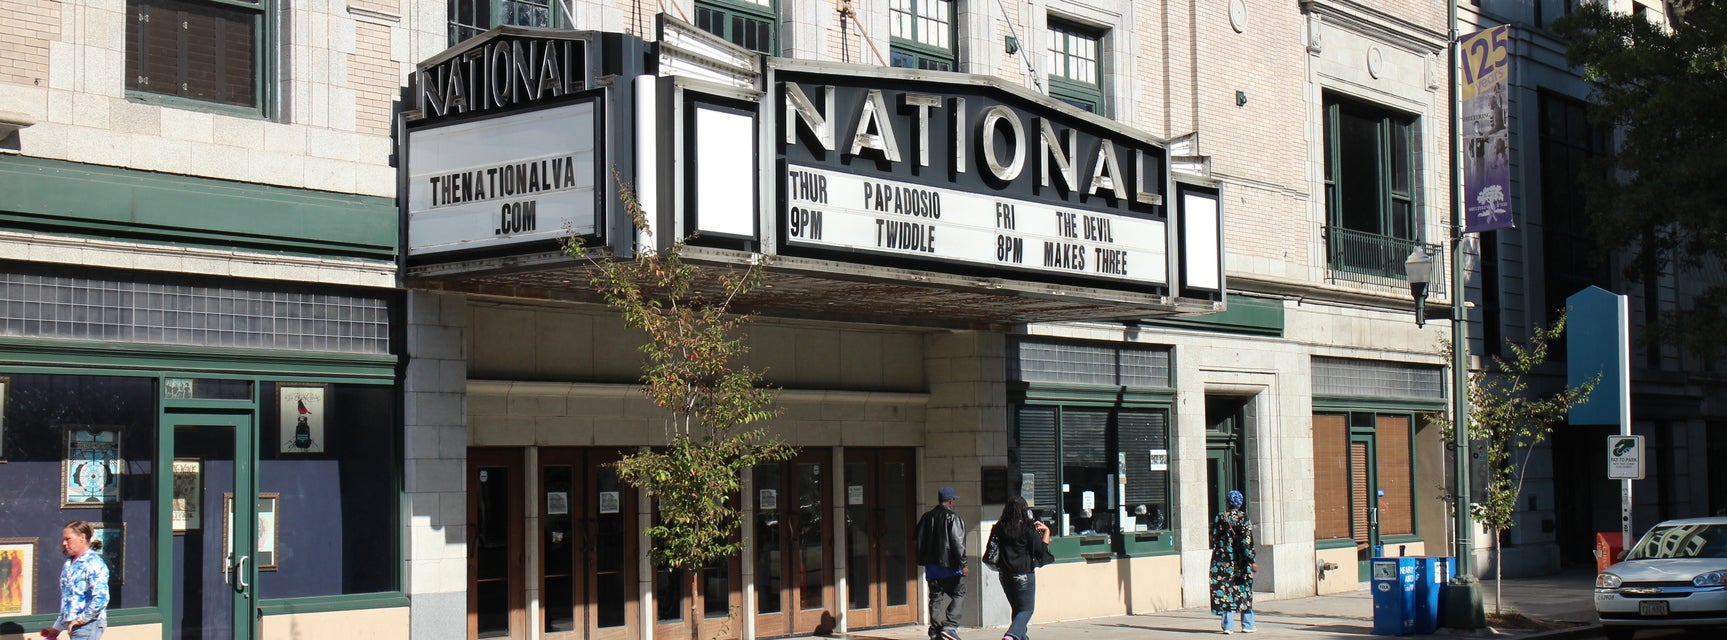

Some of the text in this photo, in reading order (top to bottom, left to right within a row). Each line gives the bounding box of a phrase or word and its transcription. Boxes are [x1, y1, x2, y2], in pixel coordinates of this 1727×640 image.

[422, 39, 585, 118] NATIONAL
[1461, 26, 1508, 84] 125
[1475, 68, 1504, 94] years
[784, 81, 1162, 206] NATIONAL
[430, 156, 575, 206] THENATIONALVA
[789, 170, 941, 220] THUR PAPADOSIO
[495, 200, 536, 235] .COM
[790, 206, 935, 253] 9PM TWIDDLE
[996, 202, 1114, 243] FRI THE DEVIL
[997, 234, 1127, 275] 8PM MAKES THREE
